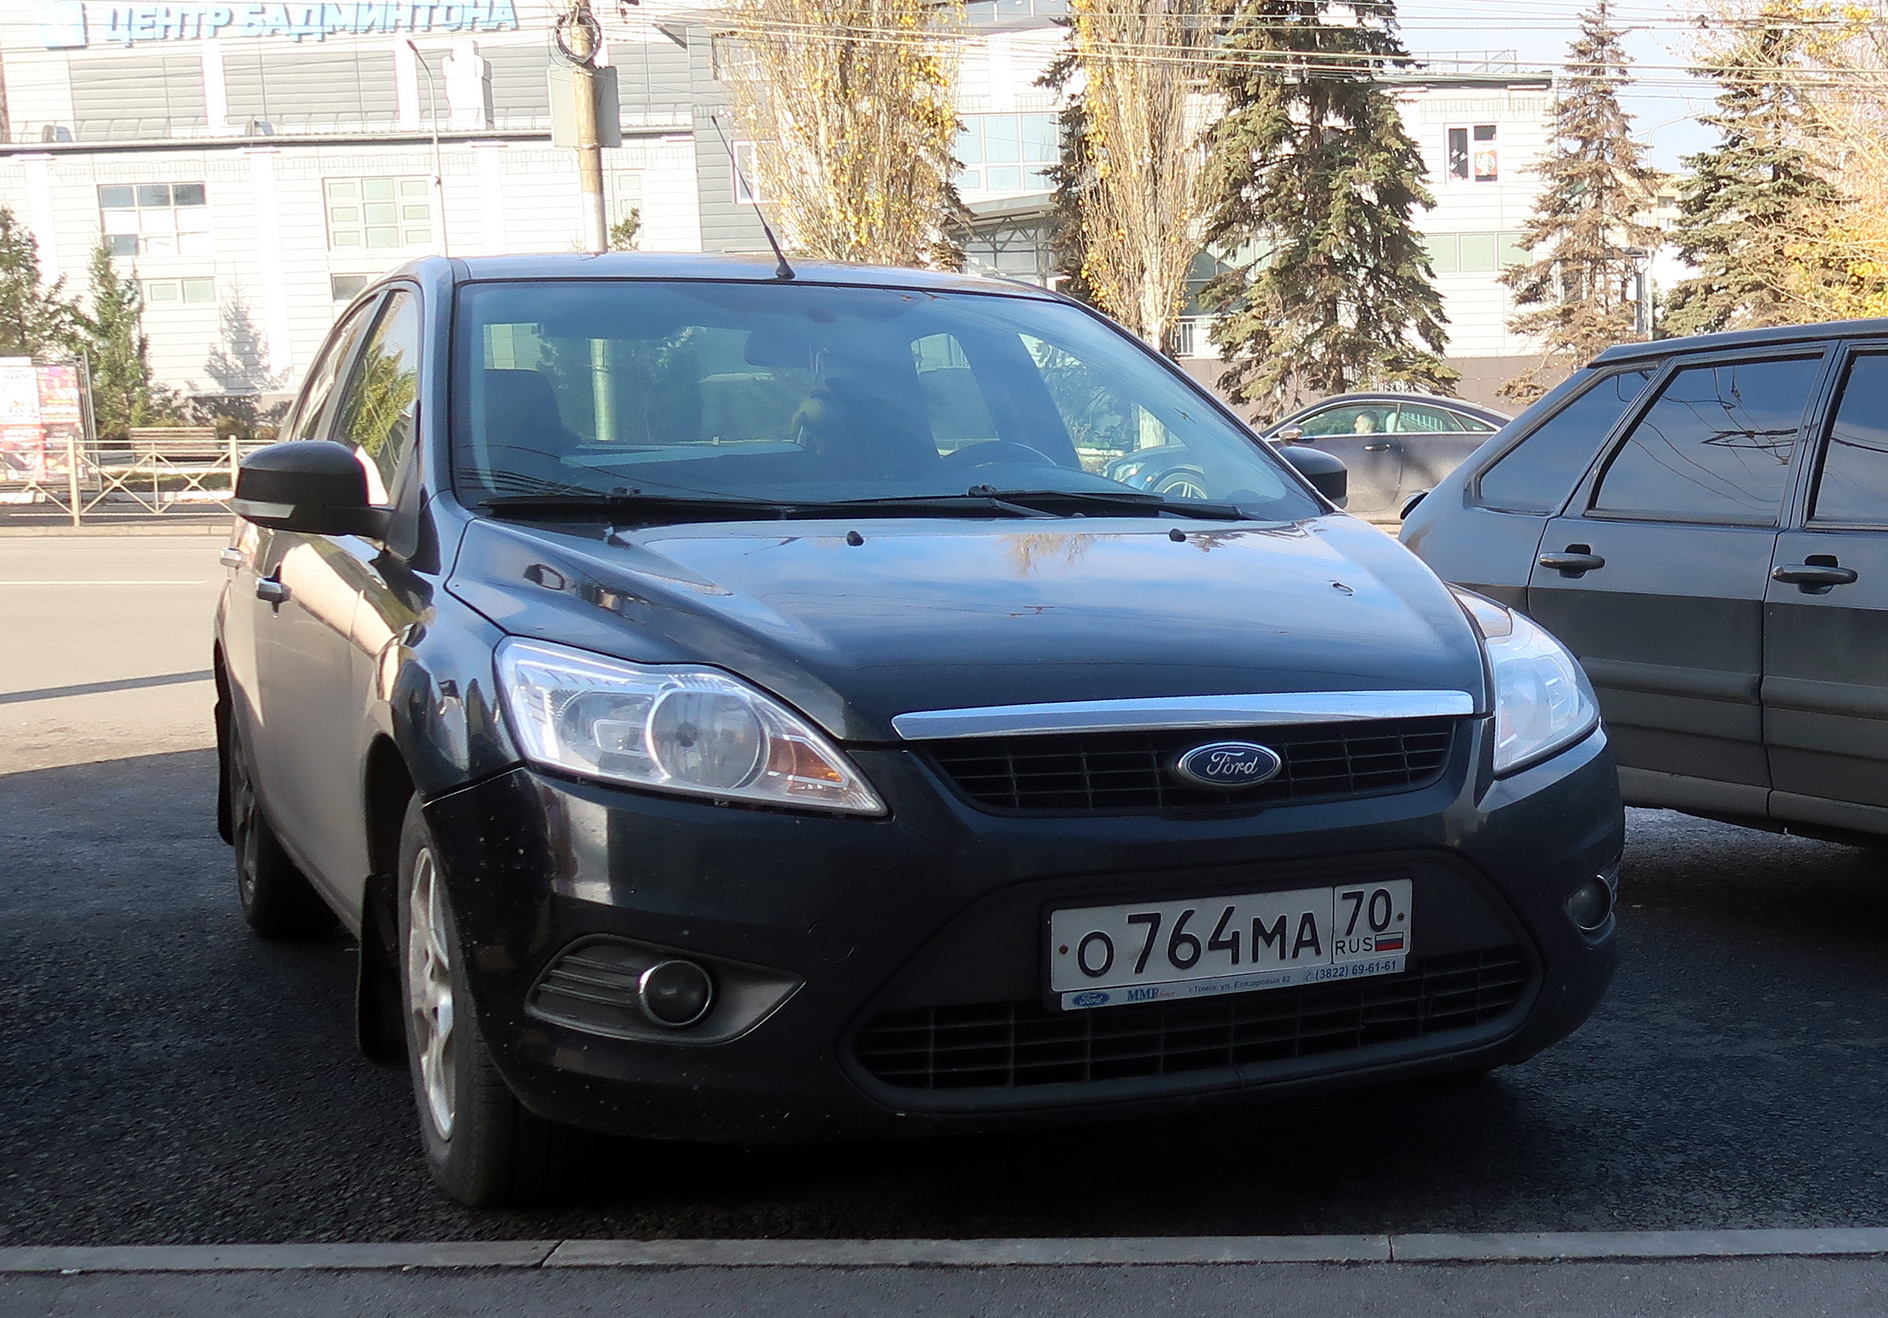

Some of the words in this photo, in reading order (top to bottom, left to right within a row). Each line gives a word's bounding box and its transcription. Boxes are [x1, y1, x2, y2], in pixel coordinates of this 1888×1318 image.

[104, 5, 234, 48] ЦЕНТР
[241, 0, 519, 43] БАДМИНТОНА
[1206, 751, 1259, 776] Ford
[1341, 888, 1393, 937] 70
[1334, 937, 1375, 956] RUS
[1315, 965, 1349, 982] (3822)
[1351, 960, 1397, 977] 69-61-61
[1079, 993, 1104, 1005] Ford
